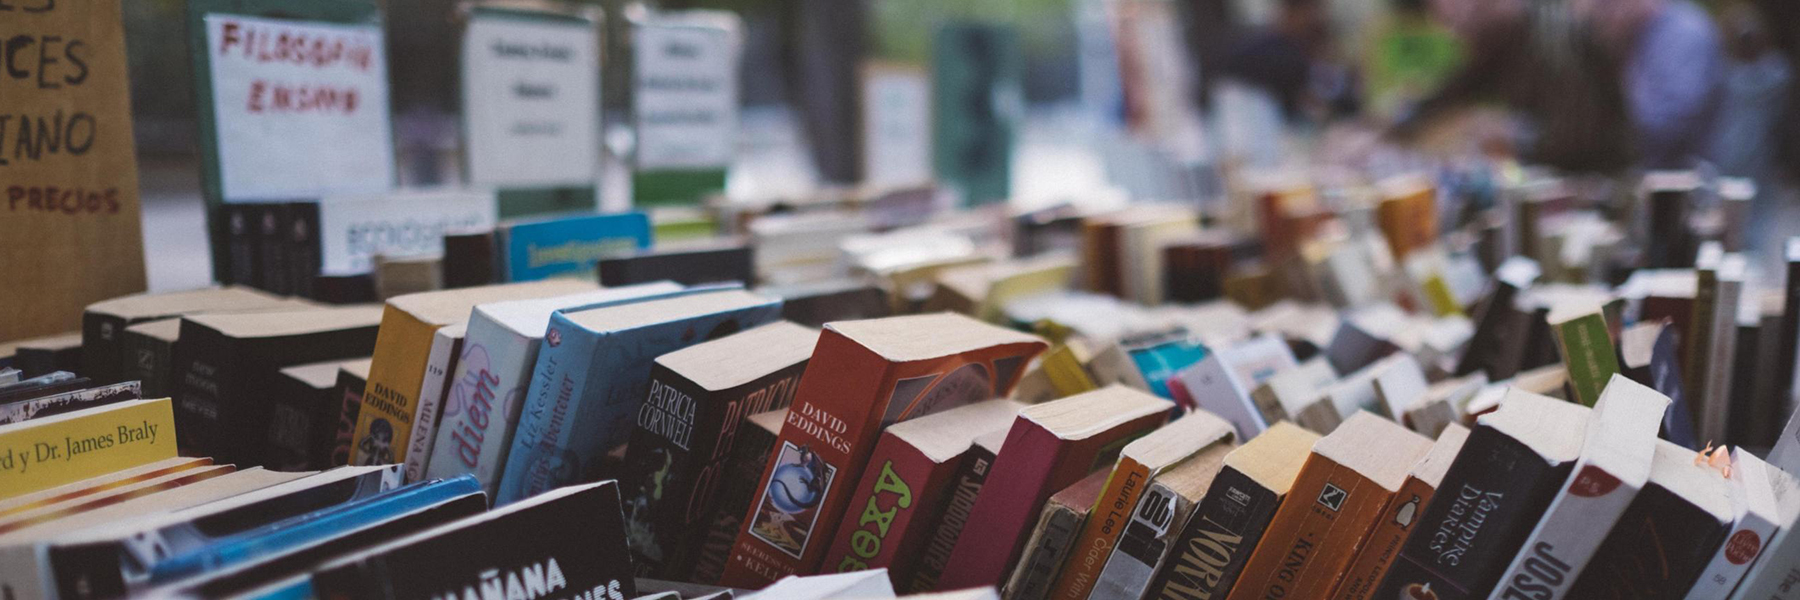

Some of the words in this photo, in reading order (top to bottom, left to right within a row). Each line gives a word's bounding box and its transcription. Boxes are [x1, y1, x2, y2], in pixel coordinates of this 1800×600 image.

[0, 34, 89, 89] CES
[7, 185, 119, 215] PRECIOS
[428, 365, 443, 376] 119
[530, 356, 558, 421] Kessler
[364, 391, 410, 424] EDDINGS
[374, 382, 408, 408] DAVID
[539, 373, 574, 453] Abenteuer
[647, 379, 697, 425] PATRICIA
[412, 398, 433, 453] MILENA
[452, 367, 500, 469] diem
[520, 423, 541, 450] Liz
[637, 402, 693, 451] CORNWELL
[787, 411, 852, 455] EDDINGS
[801, 401, 847, 435] DAVID
[18, 450, 31, 474] y
[34, 442, 62, 463] Dr.
[65, 432, 114, 461] James
[117, 420, 159, 445] Braly
[1114, 471, 1143, 511] Laurie
[1101, 511, 1122, 535] Lee
[1430, 483, 1482, 554] Diaries
[1437, 490, 1504, 567] Vampire
[1083, 537, 1112, 571] Cider
[1158, 514, 1244, 600] NORA
[1278, 538, 1314, 583] KING
[1067, 572, 1091, 600] With
[1264, 583, 1285, 600] O
